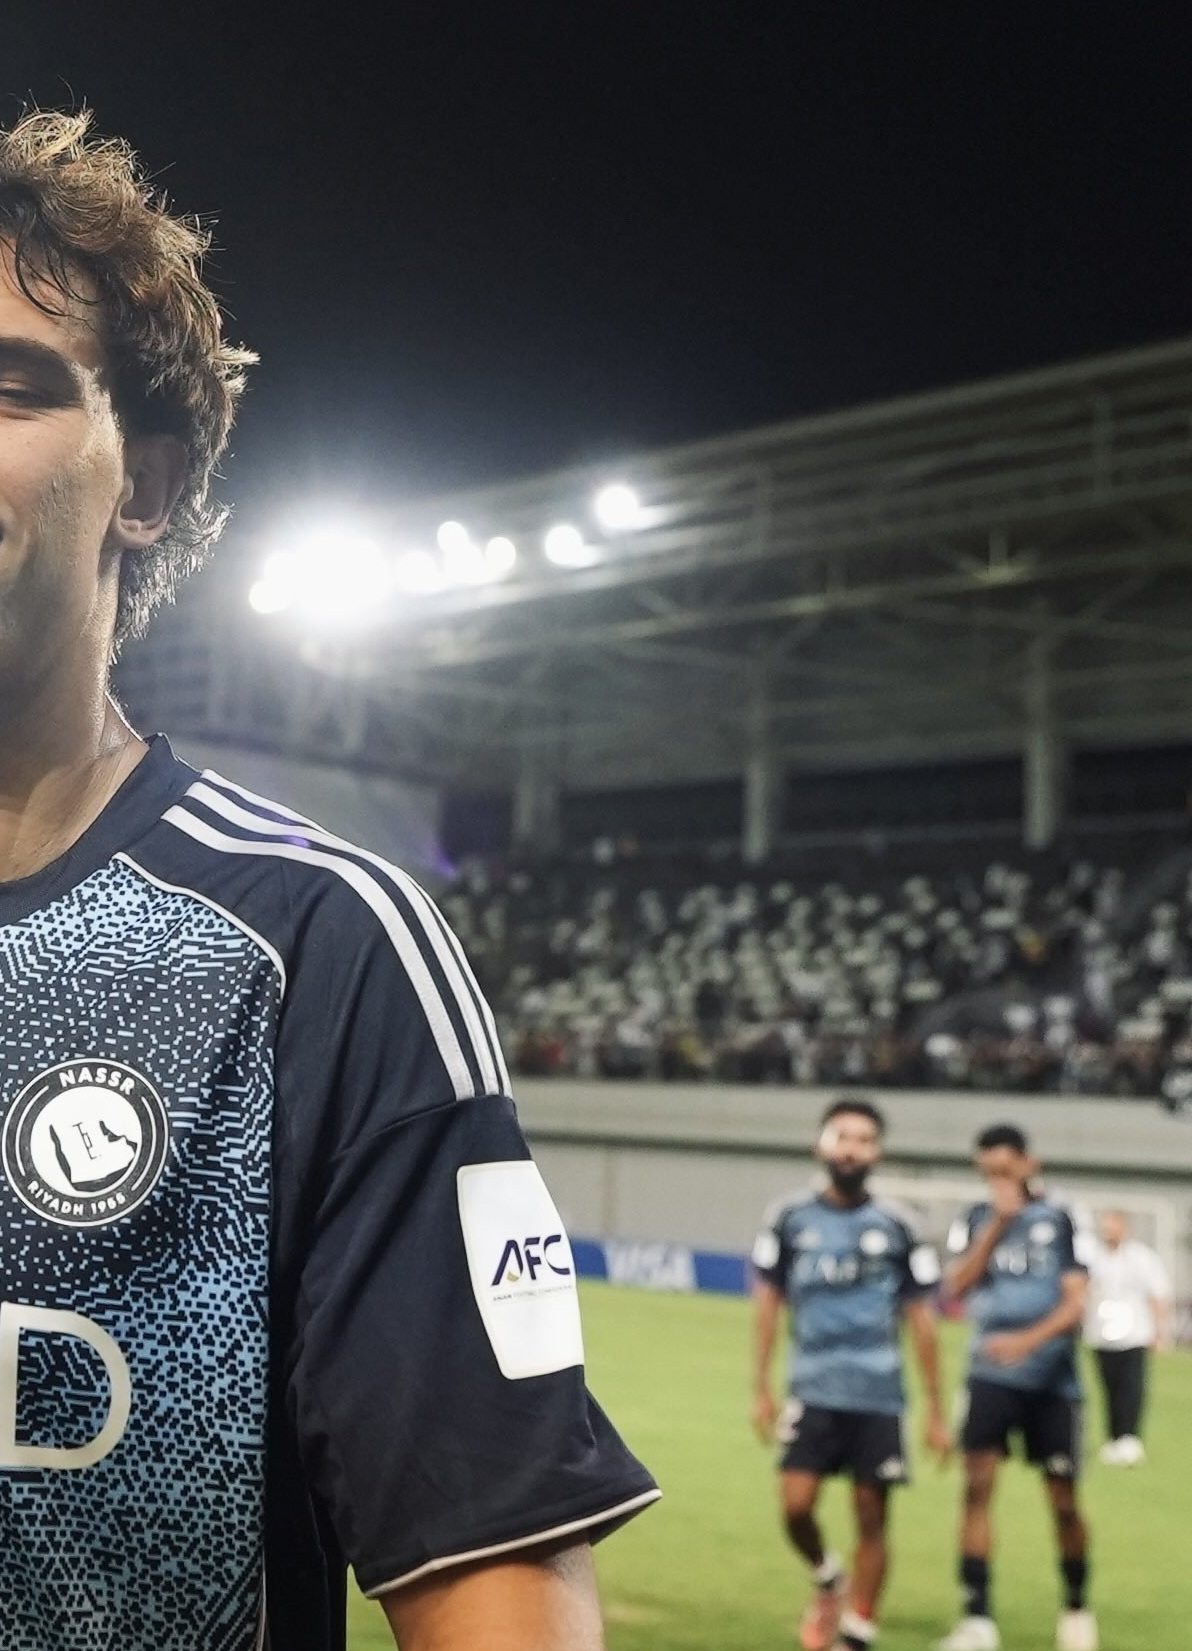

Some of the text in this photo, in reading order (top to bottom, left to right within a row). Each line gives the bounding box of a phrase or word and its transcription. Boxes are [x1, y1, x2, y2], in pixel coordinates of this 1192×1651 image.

[58, 1067, 135, 1095] NASSR
[27, 1180, 84, 1216] RIYADH
[491, 1234, 571, 1286] AFC
